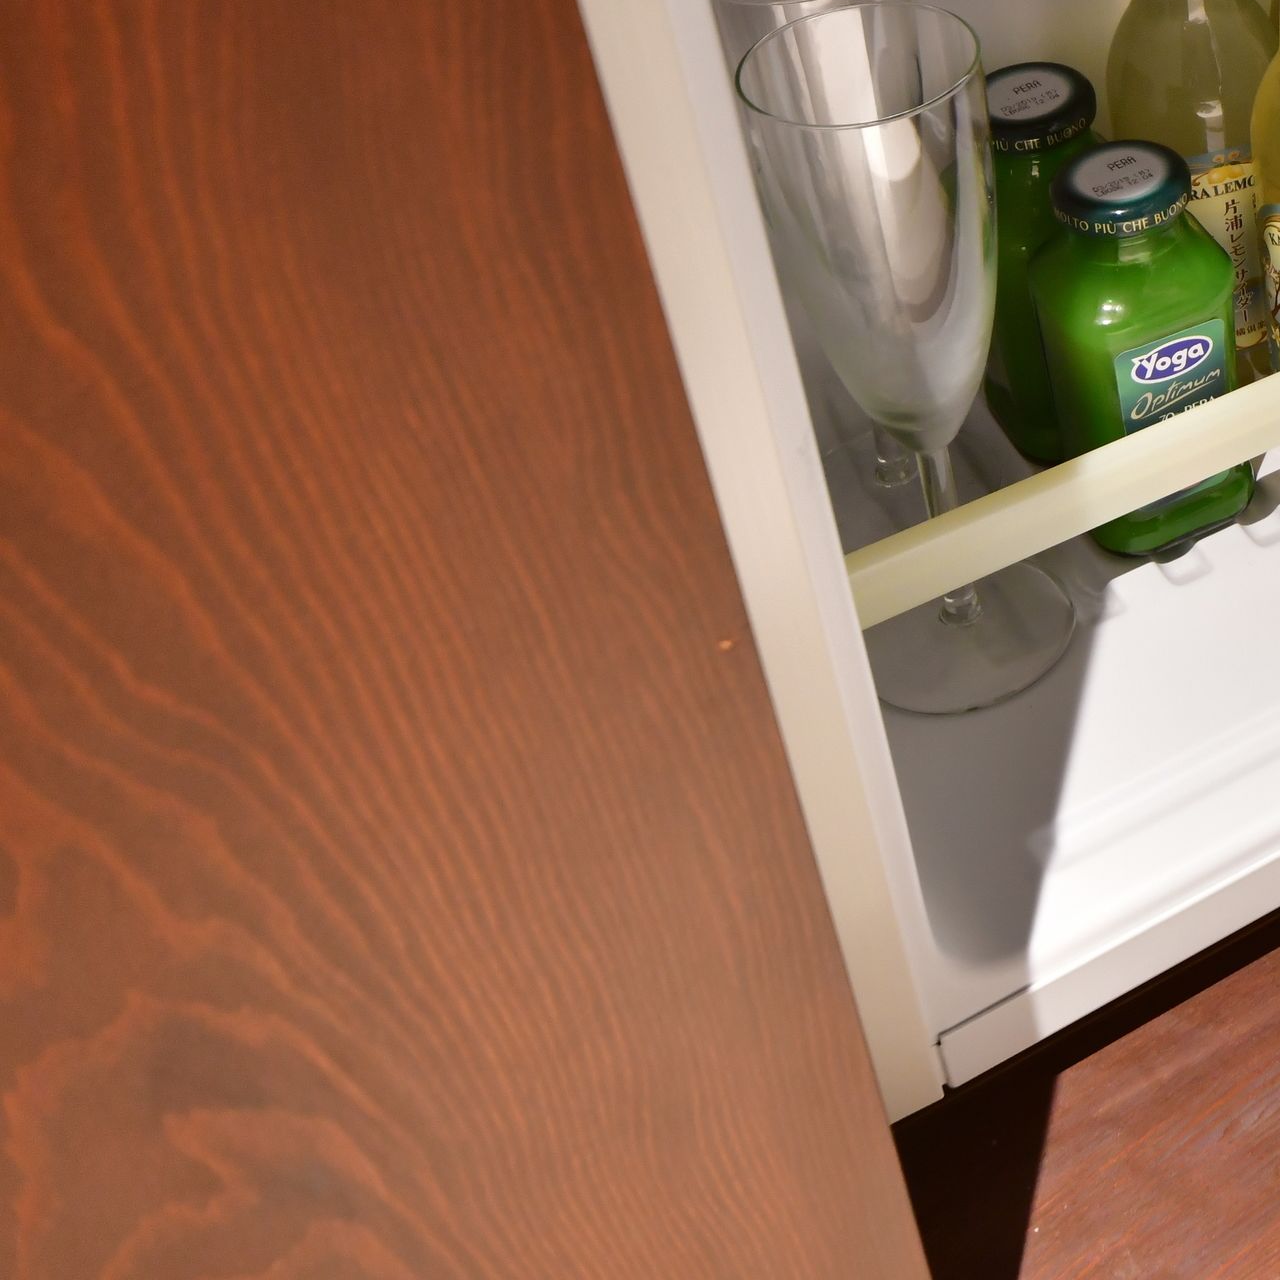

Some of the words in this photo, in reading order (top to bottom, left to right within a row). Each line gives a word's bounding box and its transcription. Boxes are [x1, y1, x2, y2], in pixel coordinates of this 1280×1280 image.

[1012, 80, 1042, 96] PERA
[1014, 137, 1041, 152] CHE
[1046, 117, 1087, 147] BUONO
[1107, 156, 1137, 173] PERA
[1094, 220, 1118, 235] PIÙ
[1122, 216, 1150, 234] CHE
[1154, 191, 1189, 226] BUONO
[1139, 341, 1207, 380] Yoga
[1130, 367, 1222, 421] Optimum
